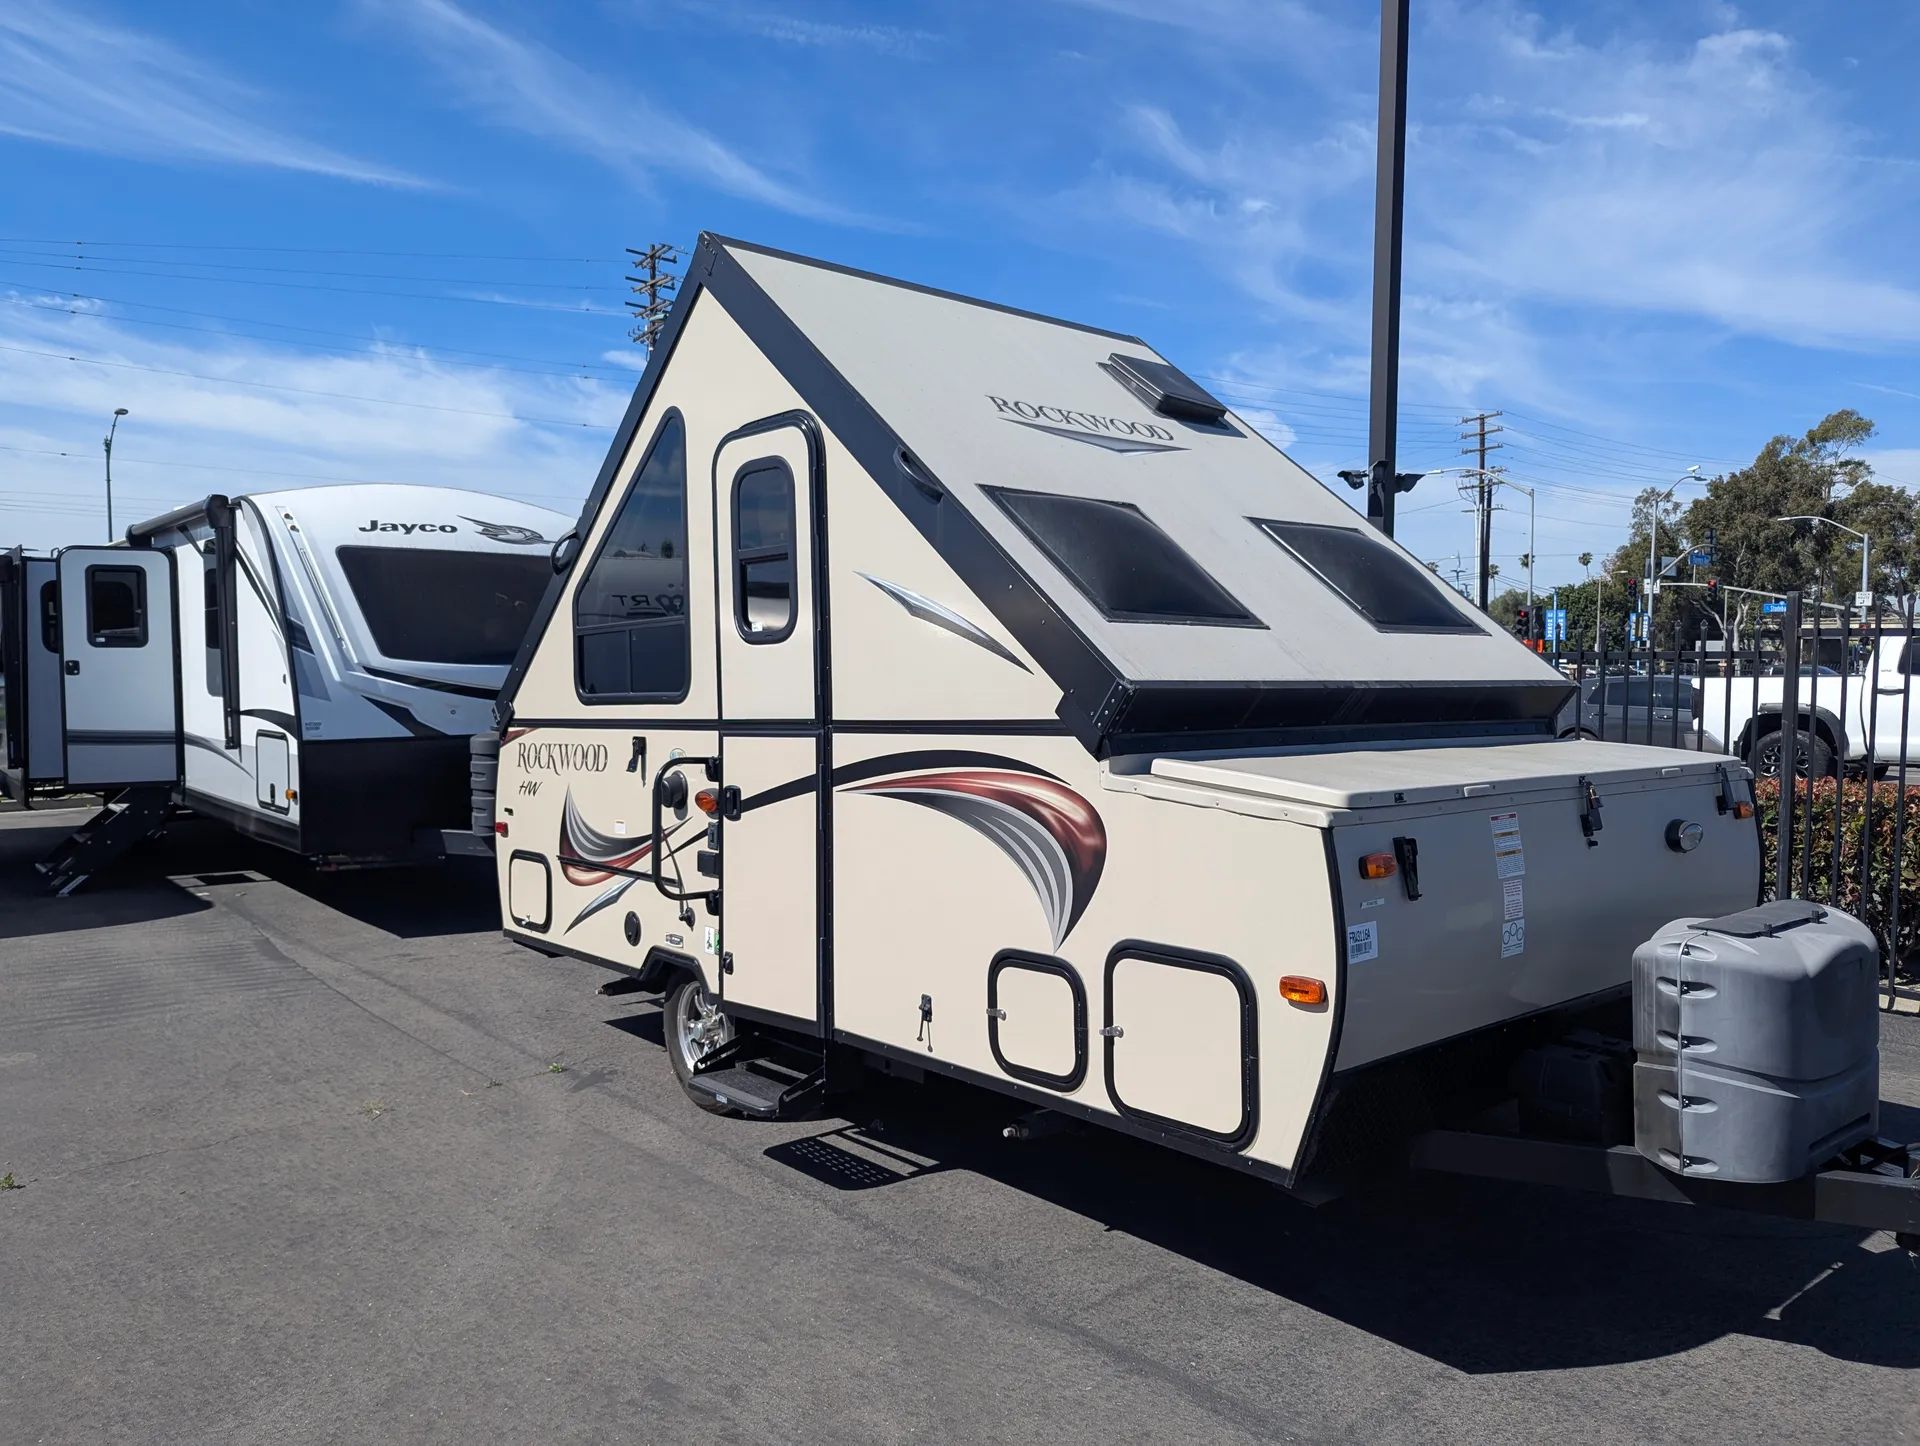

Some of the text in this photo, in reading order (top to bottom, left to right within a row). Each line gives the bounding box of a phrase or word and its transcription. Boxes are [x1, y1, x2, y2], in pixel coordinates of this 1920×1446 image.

[984, 394, 1175, 442] ROCKWOOD
[358, 519, 458, 535] Jayco
[1770, 605, 1787, 613] Studeba
[517, 742, 609, 776] ROCKWOOD
[518, 780, 544, 797] HW
